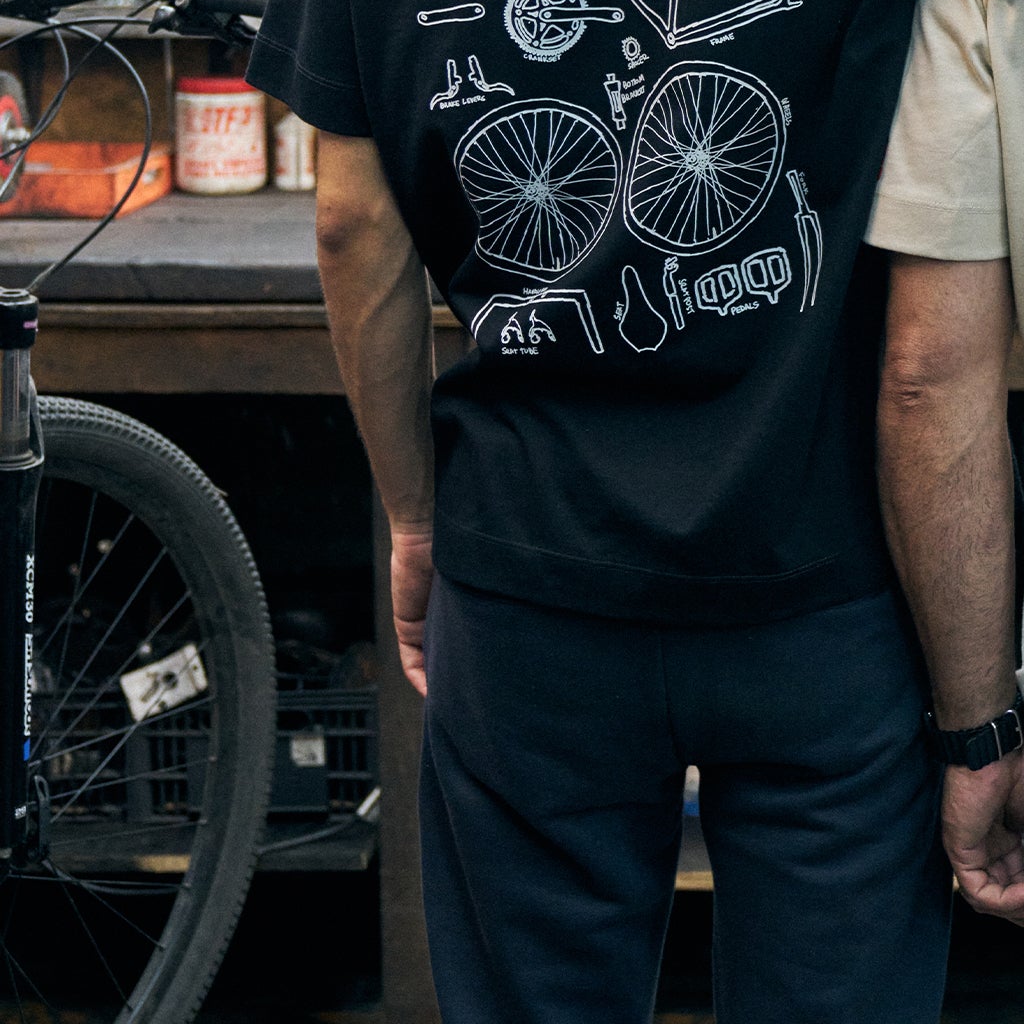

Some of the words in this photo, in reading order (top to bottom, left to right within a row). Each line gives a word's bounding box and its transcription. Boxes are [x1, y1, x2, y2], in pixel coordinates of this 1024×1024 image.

[709, 32, 735, 46] FRAME
[439, 99, 460, 110] BRAKE
[730, 301, 760, 316] PEDALS
[519, 347, 539, 355] TUBE
[25, 554, 35, 623] XCM30
